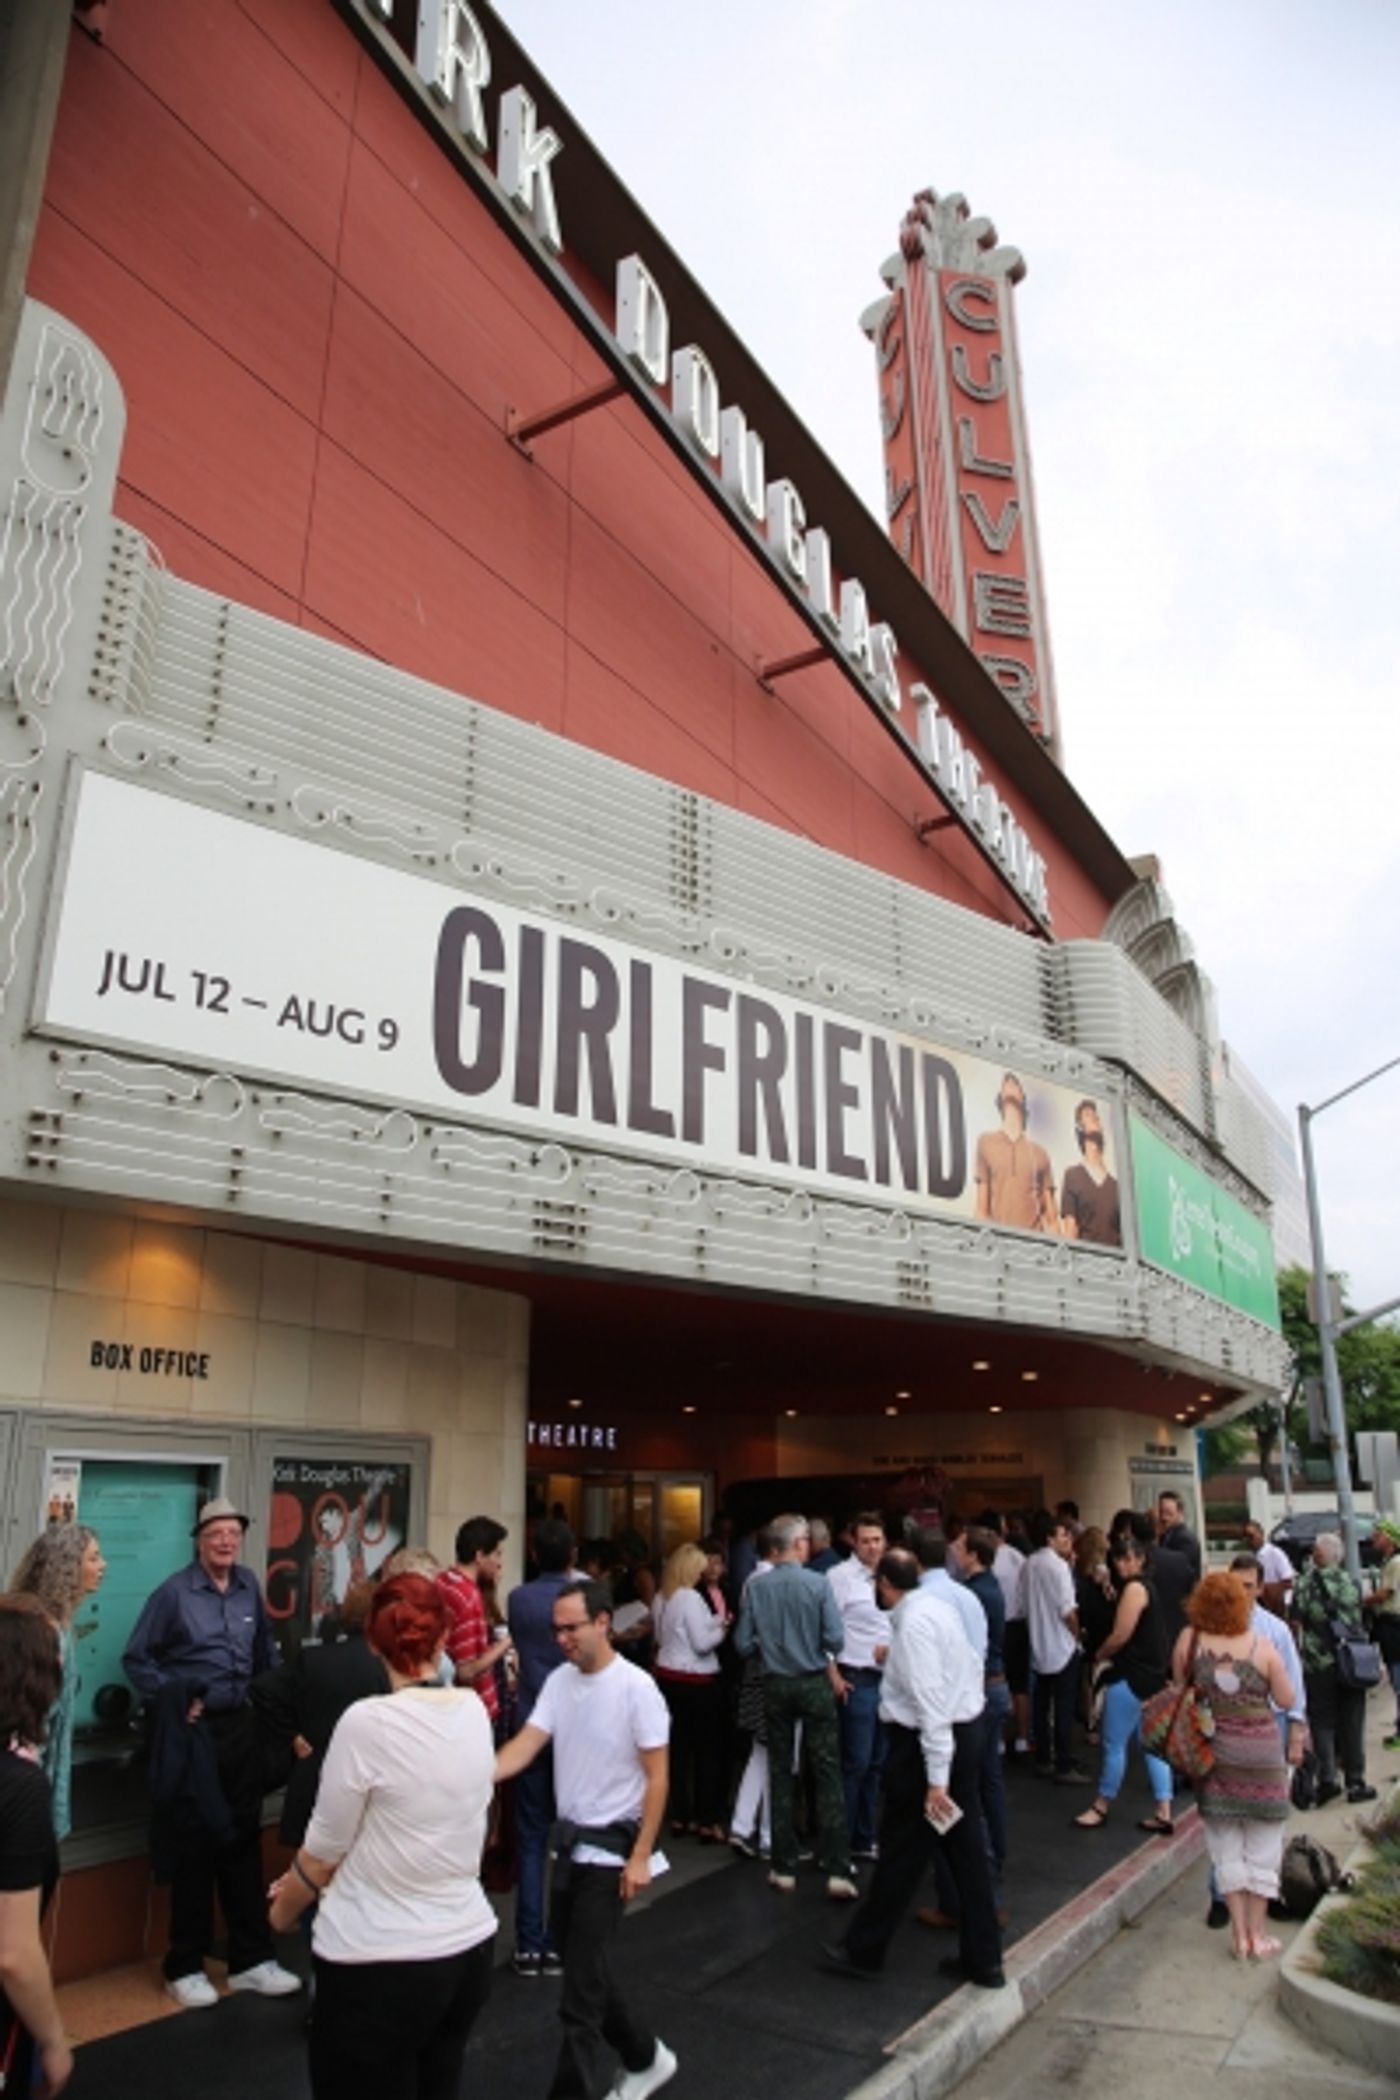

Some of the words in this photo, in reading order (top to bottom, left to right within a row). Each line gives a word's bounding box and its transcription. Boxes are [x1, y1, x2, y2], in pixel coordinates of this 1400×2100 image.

[357, 0, 563, 256] RK
[615, 253, 901, 712] DOUGLAS
[945, 278, 1036, 722] CULVER
[97, 949, 175, 1002] JUL
[190, 970, 231, 1014] 12
[276, 995, 365, 1044] AUG
[377, 1017, 399, 1051] 9
[433, 905, 967, 1199] GIRLFRIEND
[91, 1341, 133, 1370] BOX
[140, 1347, 211, 1379] OFFICE
[300, 1466, 350, 1488] Douglas
[528, 1422, 617, 1450] THEATRE
